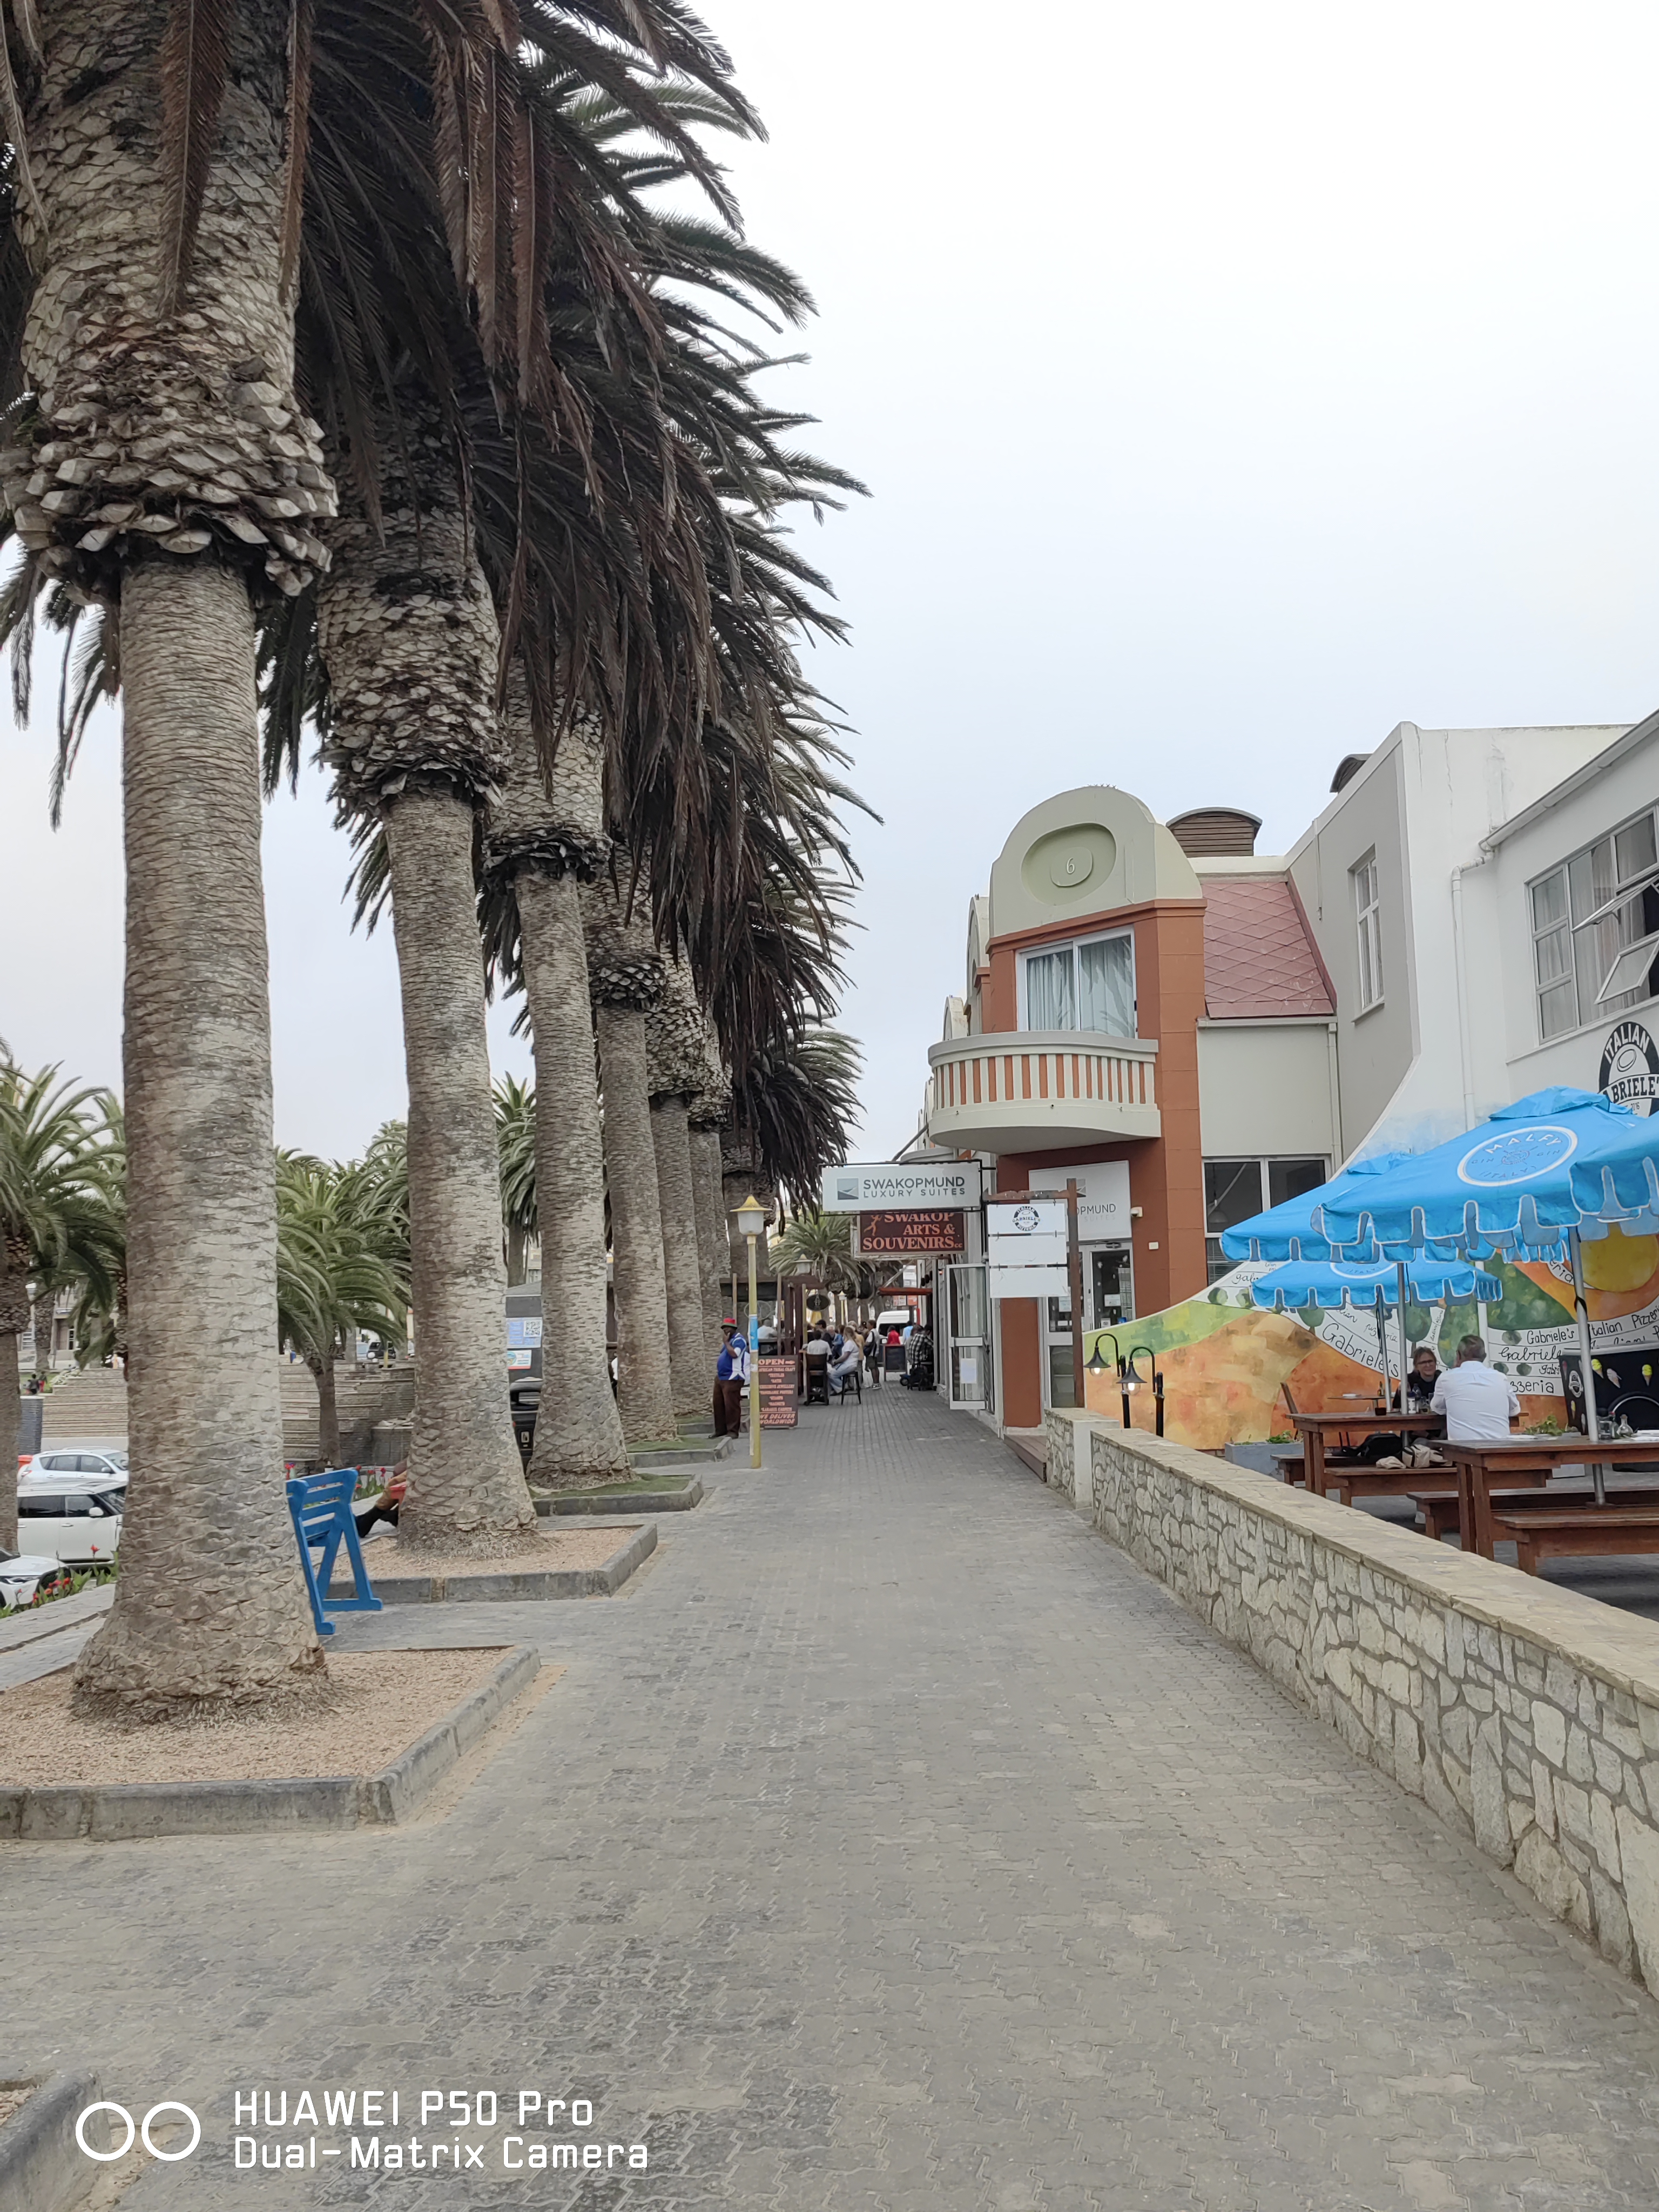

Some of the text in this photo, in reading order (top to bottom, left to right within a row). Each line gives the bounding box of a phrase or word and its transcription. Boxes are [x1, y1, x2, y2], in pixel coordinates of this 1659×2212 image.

[1066, 858, 1075, 874] 6
[1604, 1023, 1650, 1064] ITALIAN
[1485, 1134, 1562, 1154] MALFY
[864, 1177, 965, 1189] SWAKOPMUND
[921, 1188, 965, 1196] SUITES
[884, 1212, 954, 1222] SWAKOP
[903, 1224, 955, 1235] ARTS &
[863, 1236, 954, 1250] SOUVENIRS
[1527, 1327, 1574, 1344] Gabriele's
[1322, 1323, 1398, 1377] Gabriele's
